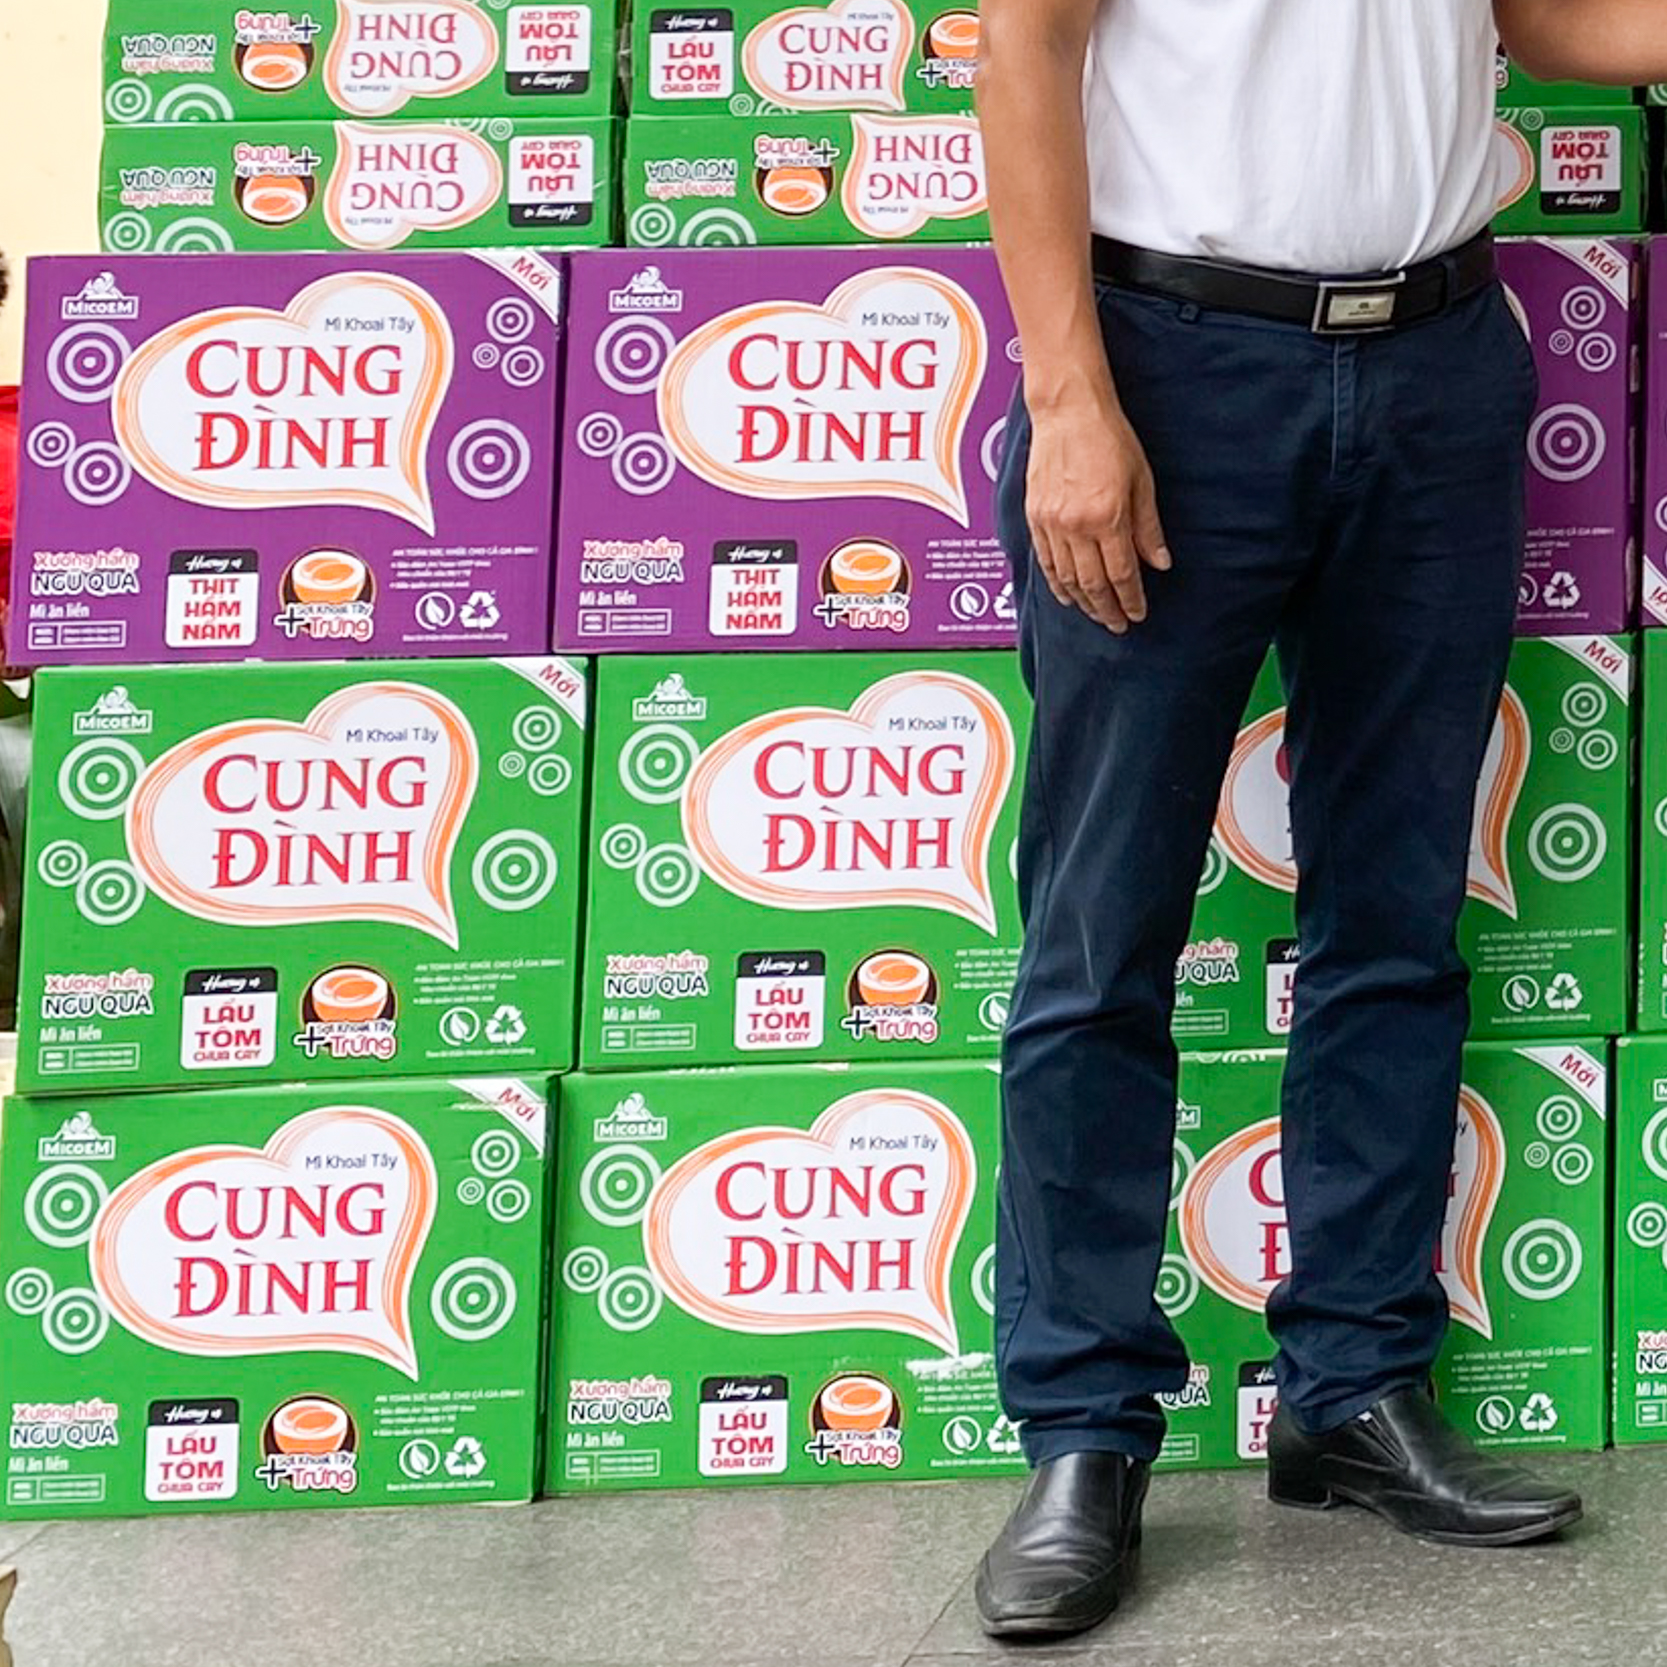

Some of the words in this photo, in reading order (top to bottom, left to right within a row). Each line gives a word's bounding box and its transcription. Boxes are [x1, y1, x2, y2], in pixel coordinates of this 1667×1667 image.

[510, 255, 549, 291] Mới
[1584, 242, 1622, 279] Mới
[1584, 244, 1623, 278] Mới
[186, 340, 403, 398] CUNG
[727, 334, 939, 391] CUNG
[192, 405, 391, 470] ĐÌNH
[734, 397, 926, 463] ĐÌNH
[538, 663, 579, 699] Mới
[539, 663, 578, 700] Mới
[1584, 638, 1624, 674] Mới
[203, 754, 428, 814] CUNG
[753, 741, 967, 799] CUNG
[210, 820, 415, 889] ĐÌNH
[762, 806, 953, 872] ĐÌNH
[195, 1024, 262, 1048] TÔM
[1560, 1053, 1597, 1088] Mới
[500, 1086, 537, 1122] Mới
[164, 1182, 386, 1242] CUNG
[715, 1161, 928, 1220] CUNG
[173, 1248, 375, 1318] ĐÌNH
[723, 1227, 916, 1296] ĐÌNH
[159, 1458, 224, 1480] TÔM
